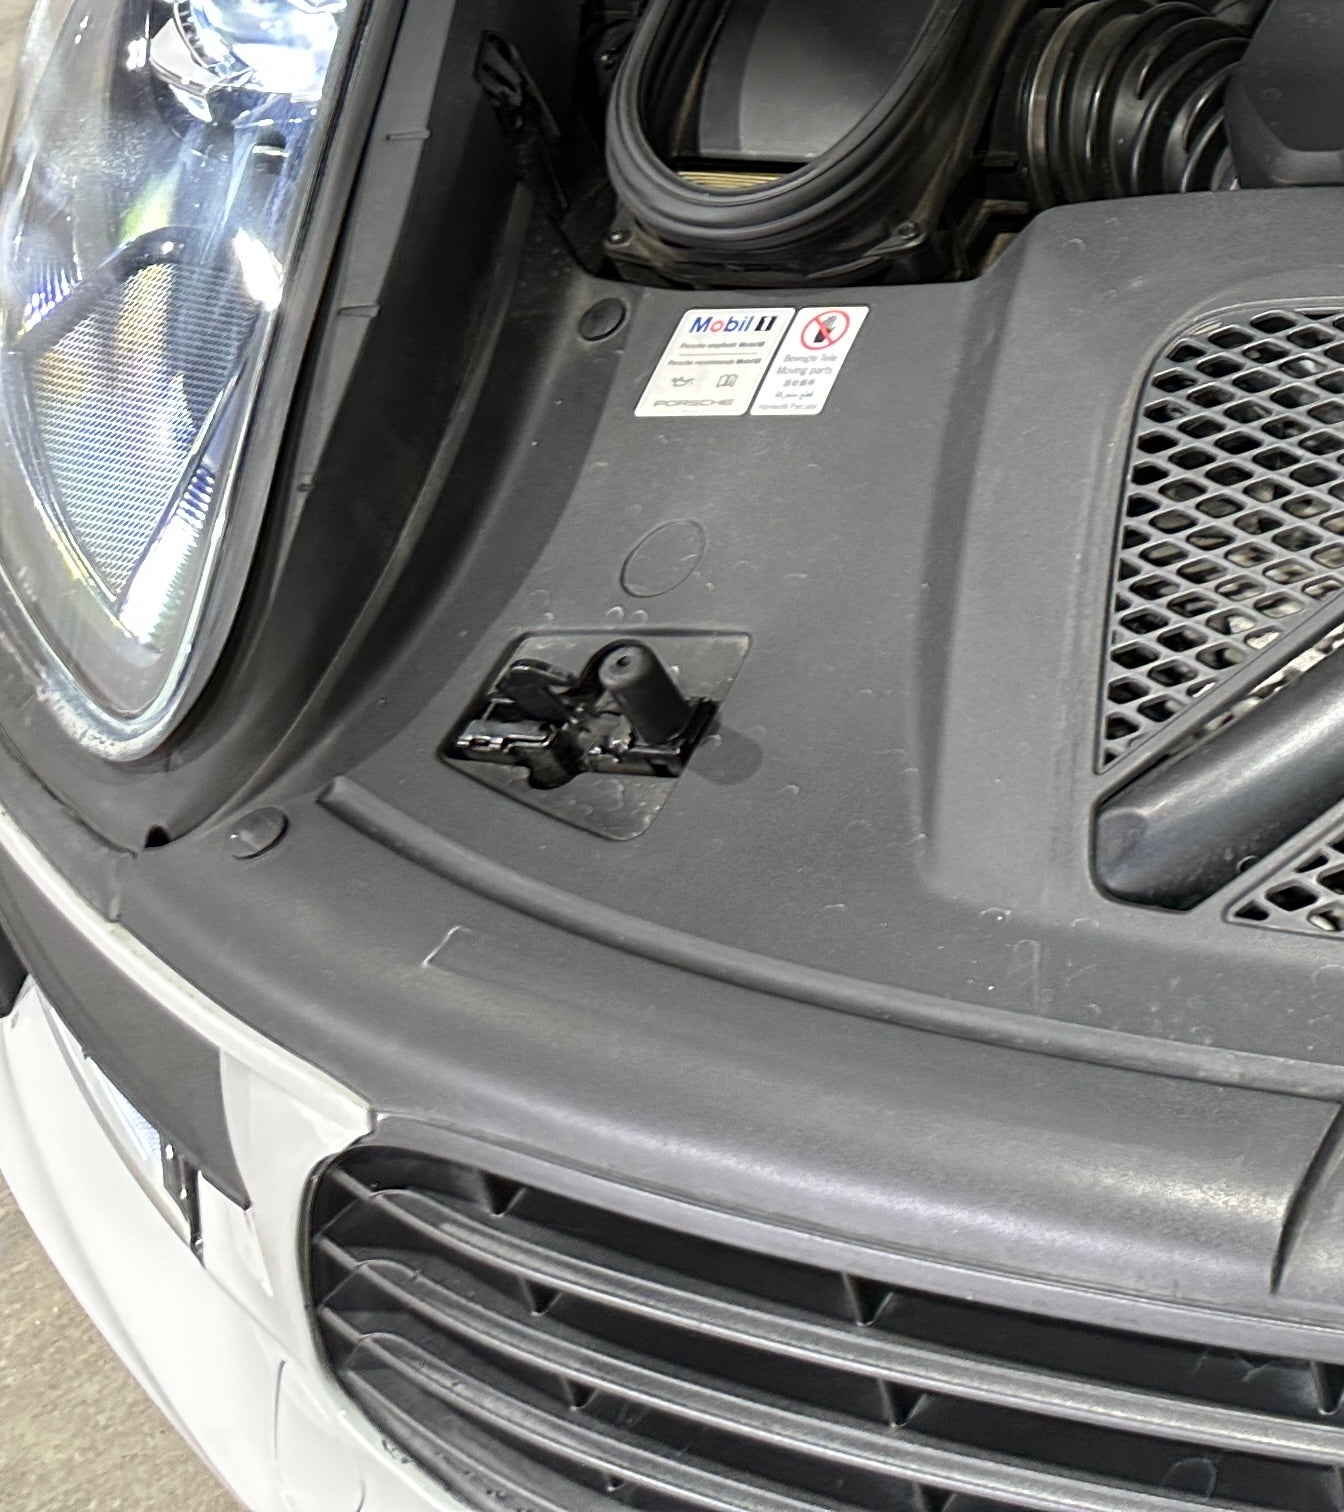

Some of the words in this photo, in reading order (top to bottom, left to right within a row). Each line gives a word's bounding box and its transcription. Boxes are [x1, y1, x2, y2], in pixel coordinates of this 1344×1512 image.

[689, 316, 754, 334] Mobil
[755, 315, 778, 332] 1
[776, 367, 808, 376] Moving
[809, 367, 833, 375] parts
[653, 399, 735, 407] PORSCHE
